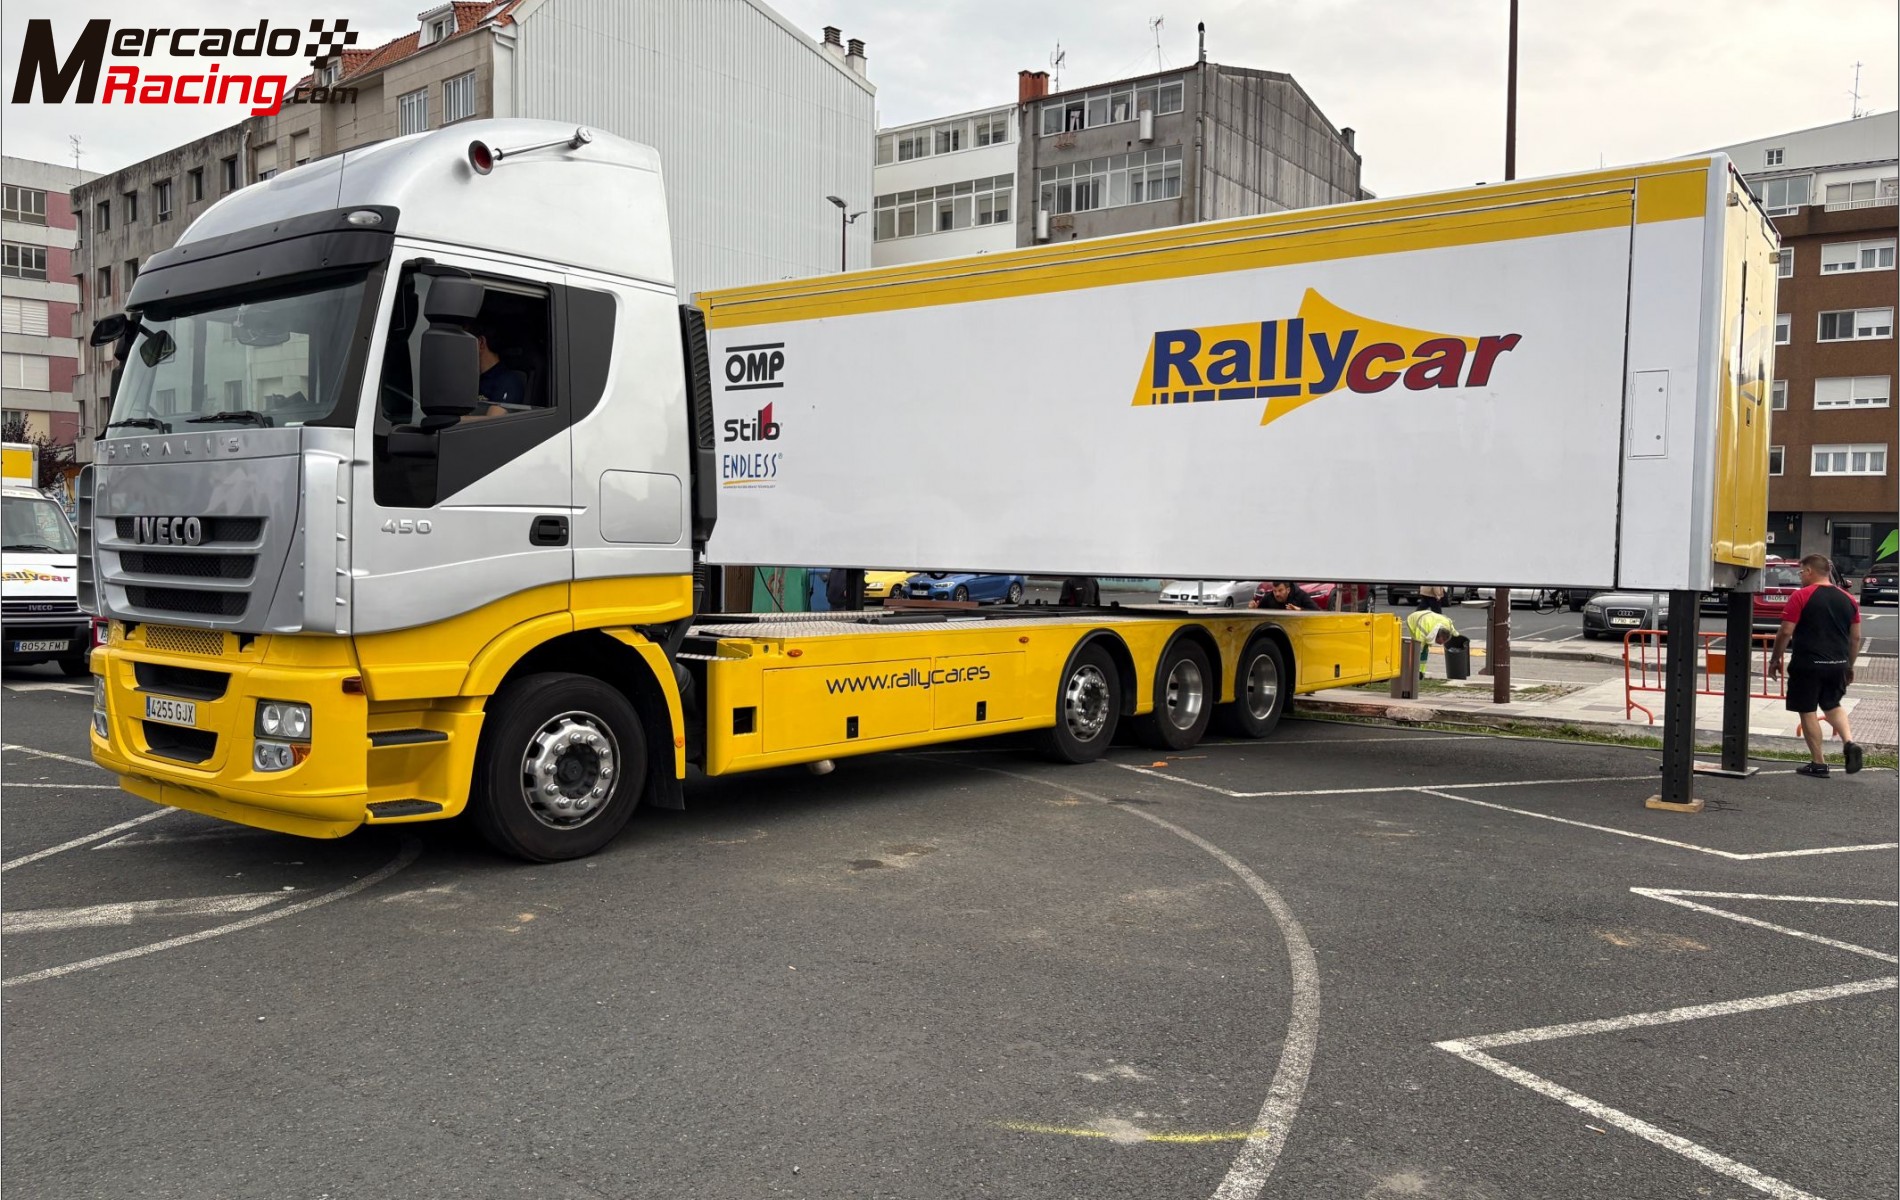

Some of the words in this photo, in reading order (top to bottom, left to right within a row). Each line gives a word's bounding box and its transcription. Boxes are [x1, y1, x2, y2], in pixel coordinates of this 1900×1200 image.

[725, 350, 785, 384] OMP
[1152, 317, 1523, 396] Rallycar
[724, 409, 780, 442] Stilo
[108, 437, 240, 459] STRALIS
[723, 453, 777, 479] ENDLESS
[133, 516, 202, 546] IVECO
[381, 519, 432, 535] 450
[28, 604, 53, 612] IVECO
[21, 641, 46, 651] 8052
[48, 641, 67, 650] FMT
[826, 666, 990, 694] www.rallycar.es
[151, 699, 174, 719] 4255
[175, 703, 194, 724] GJX
